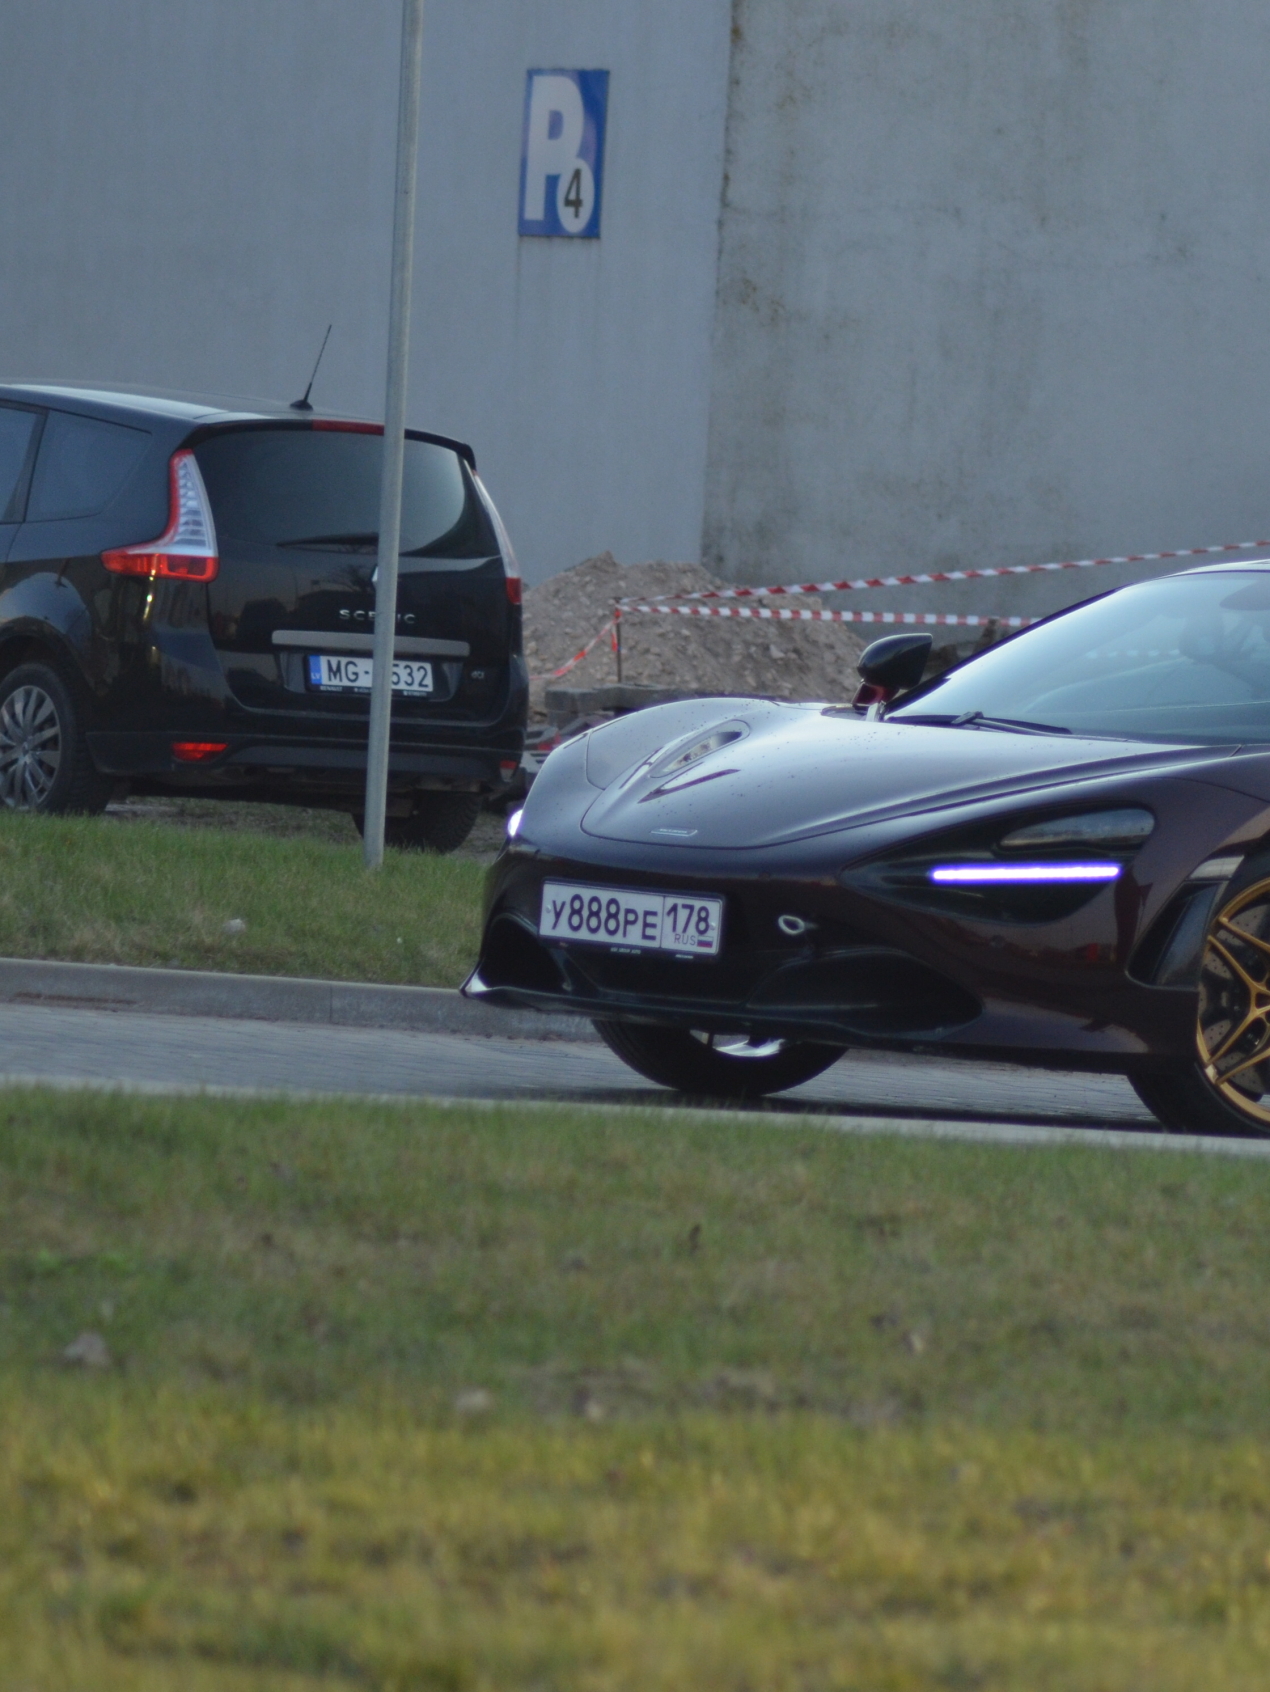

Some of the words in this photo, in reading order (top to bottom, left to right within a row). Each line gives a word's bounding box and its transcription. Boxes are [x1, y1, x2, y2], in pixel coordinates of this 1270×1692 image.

[524, 75, 584, 221] P
[564, 168, 583, 219] 4
[339, 609, 416, 624] SCEIC
[327, 659, 429, 688] MG-532
[666, 903, 710, 935] 178
[673, 933, 696, 946] RUS
